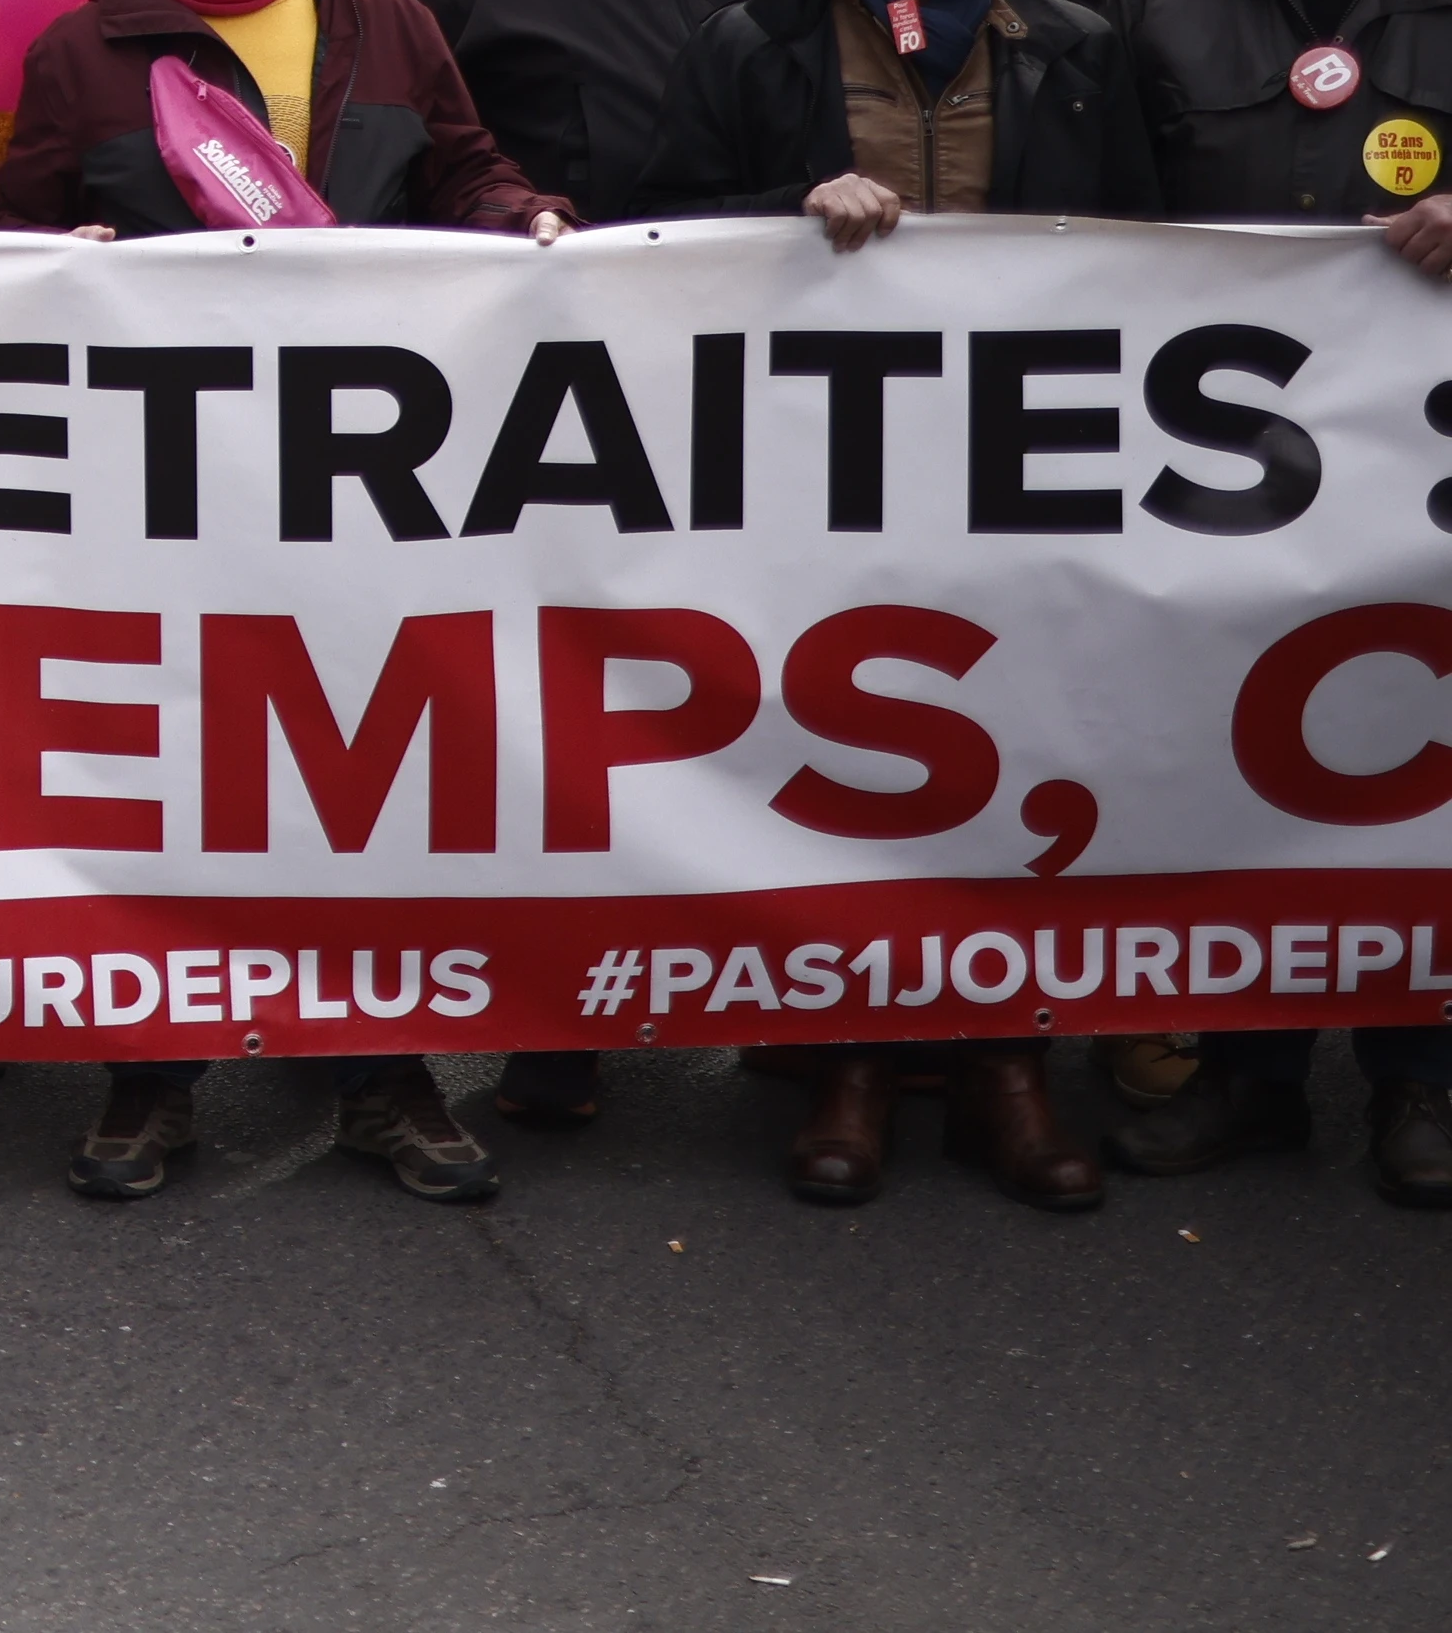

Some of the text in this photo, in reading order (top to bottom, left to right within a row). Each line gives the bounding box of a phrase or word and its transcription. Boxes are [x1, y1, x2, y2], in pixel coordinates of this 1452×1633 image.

[899, 30, 920, 53] FO
[1300, 53, 1352, 92] FO
[1377, 132, 1424, 148] 62 ans
[197, 138, 278, 222] Solidaires
[1395, 166, 1414, 185] FO
